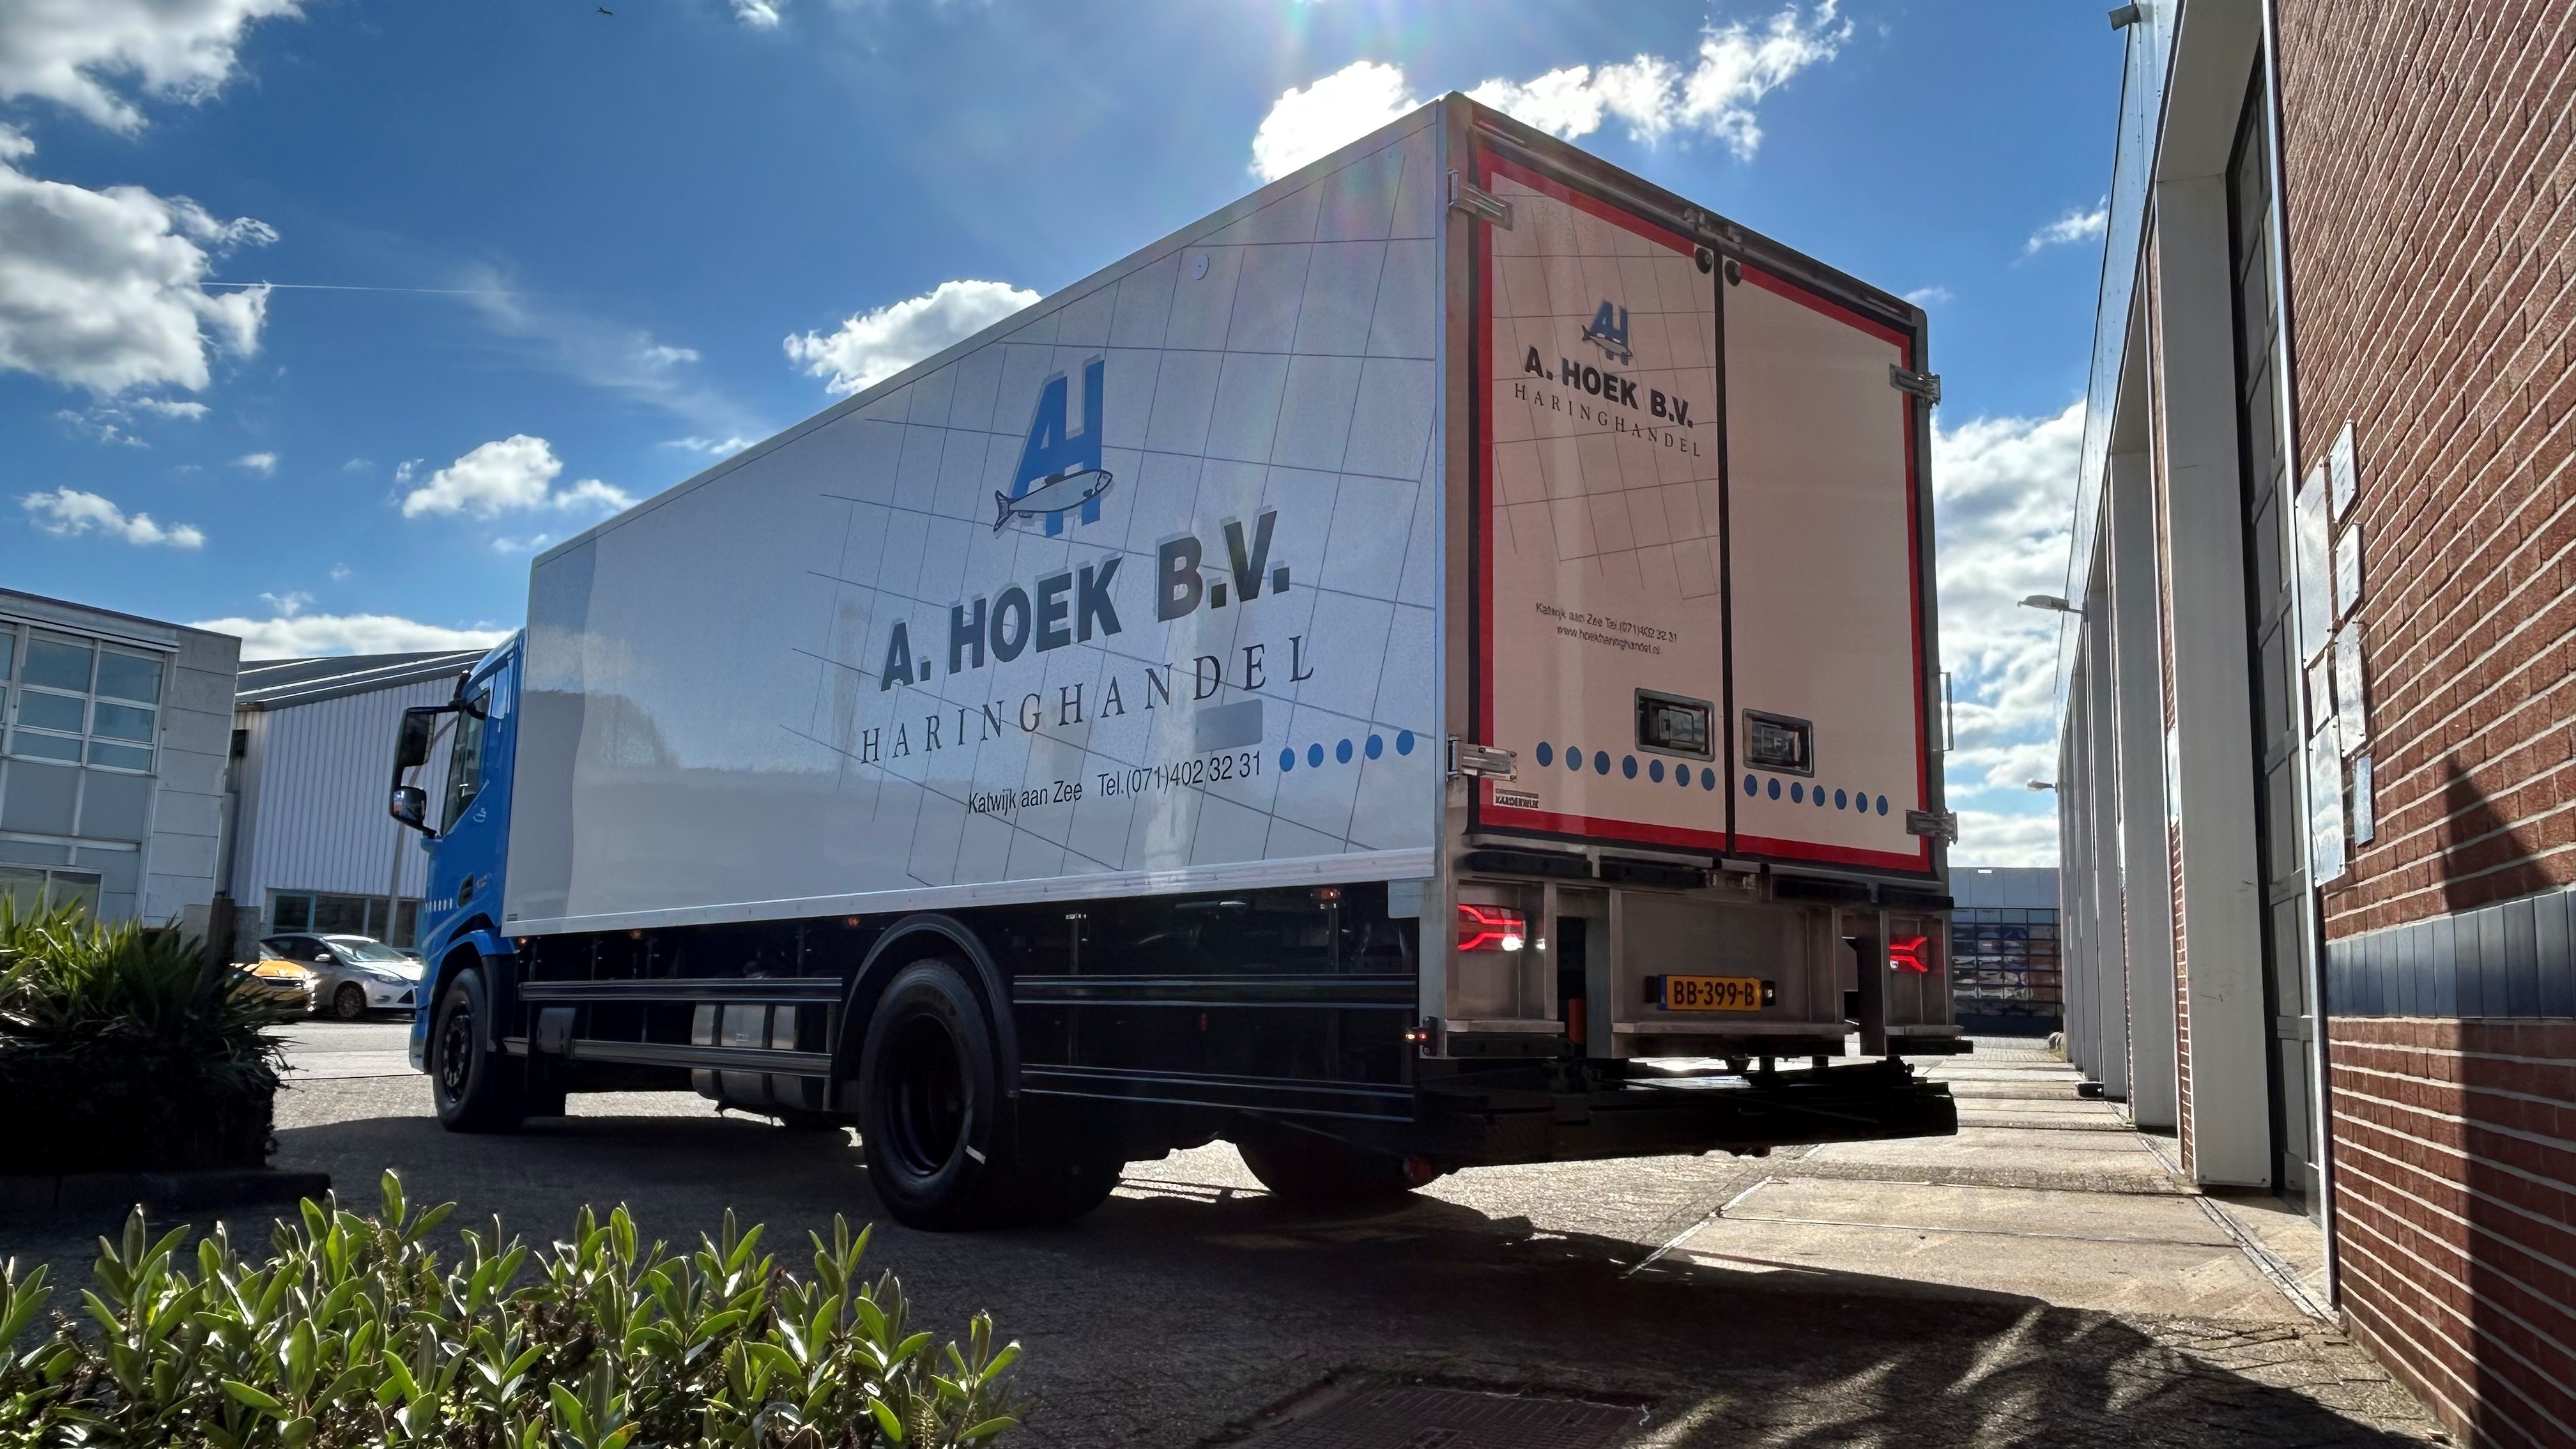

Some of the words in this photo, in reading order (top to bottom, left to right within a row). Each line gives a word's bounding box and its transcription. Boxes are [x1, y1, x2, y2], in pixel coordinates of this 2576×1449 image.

[1515, 383, 1700, 456] HARINGHANDEL
[1524, 345, 1553, 380] A.
[1561, 358, 1638, 410] HOEK
[1650, 388, 1693, 429] B.V.
[880, 620, 931, 691] A.
[949, 555, 1123, 675] HOEK
[1157, 510, 1290, 622] B.V.
[861, 635, 1314, 764] HARINGHANDEL
[968, 788, 1016, 816] Katwijk
[1021, 787, 1048, 808] aan
[1053, 780, 1083, 804] Zee
[1209, 755, 1232, 782] 32
[1239, 750, 1261, 778] 31
[1674, 980, 1755, 1007] BB-399-B
